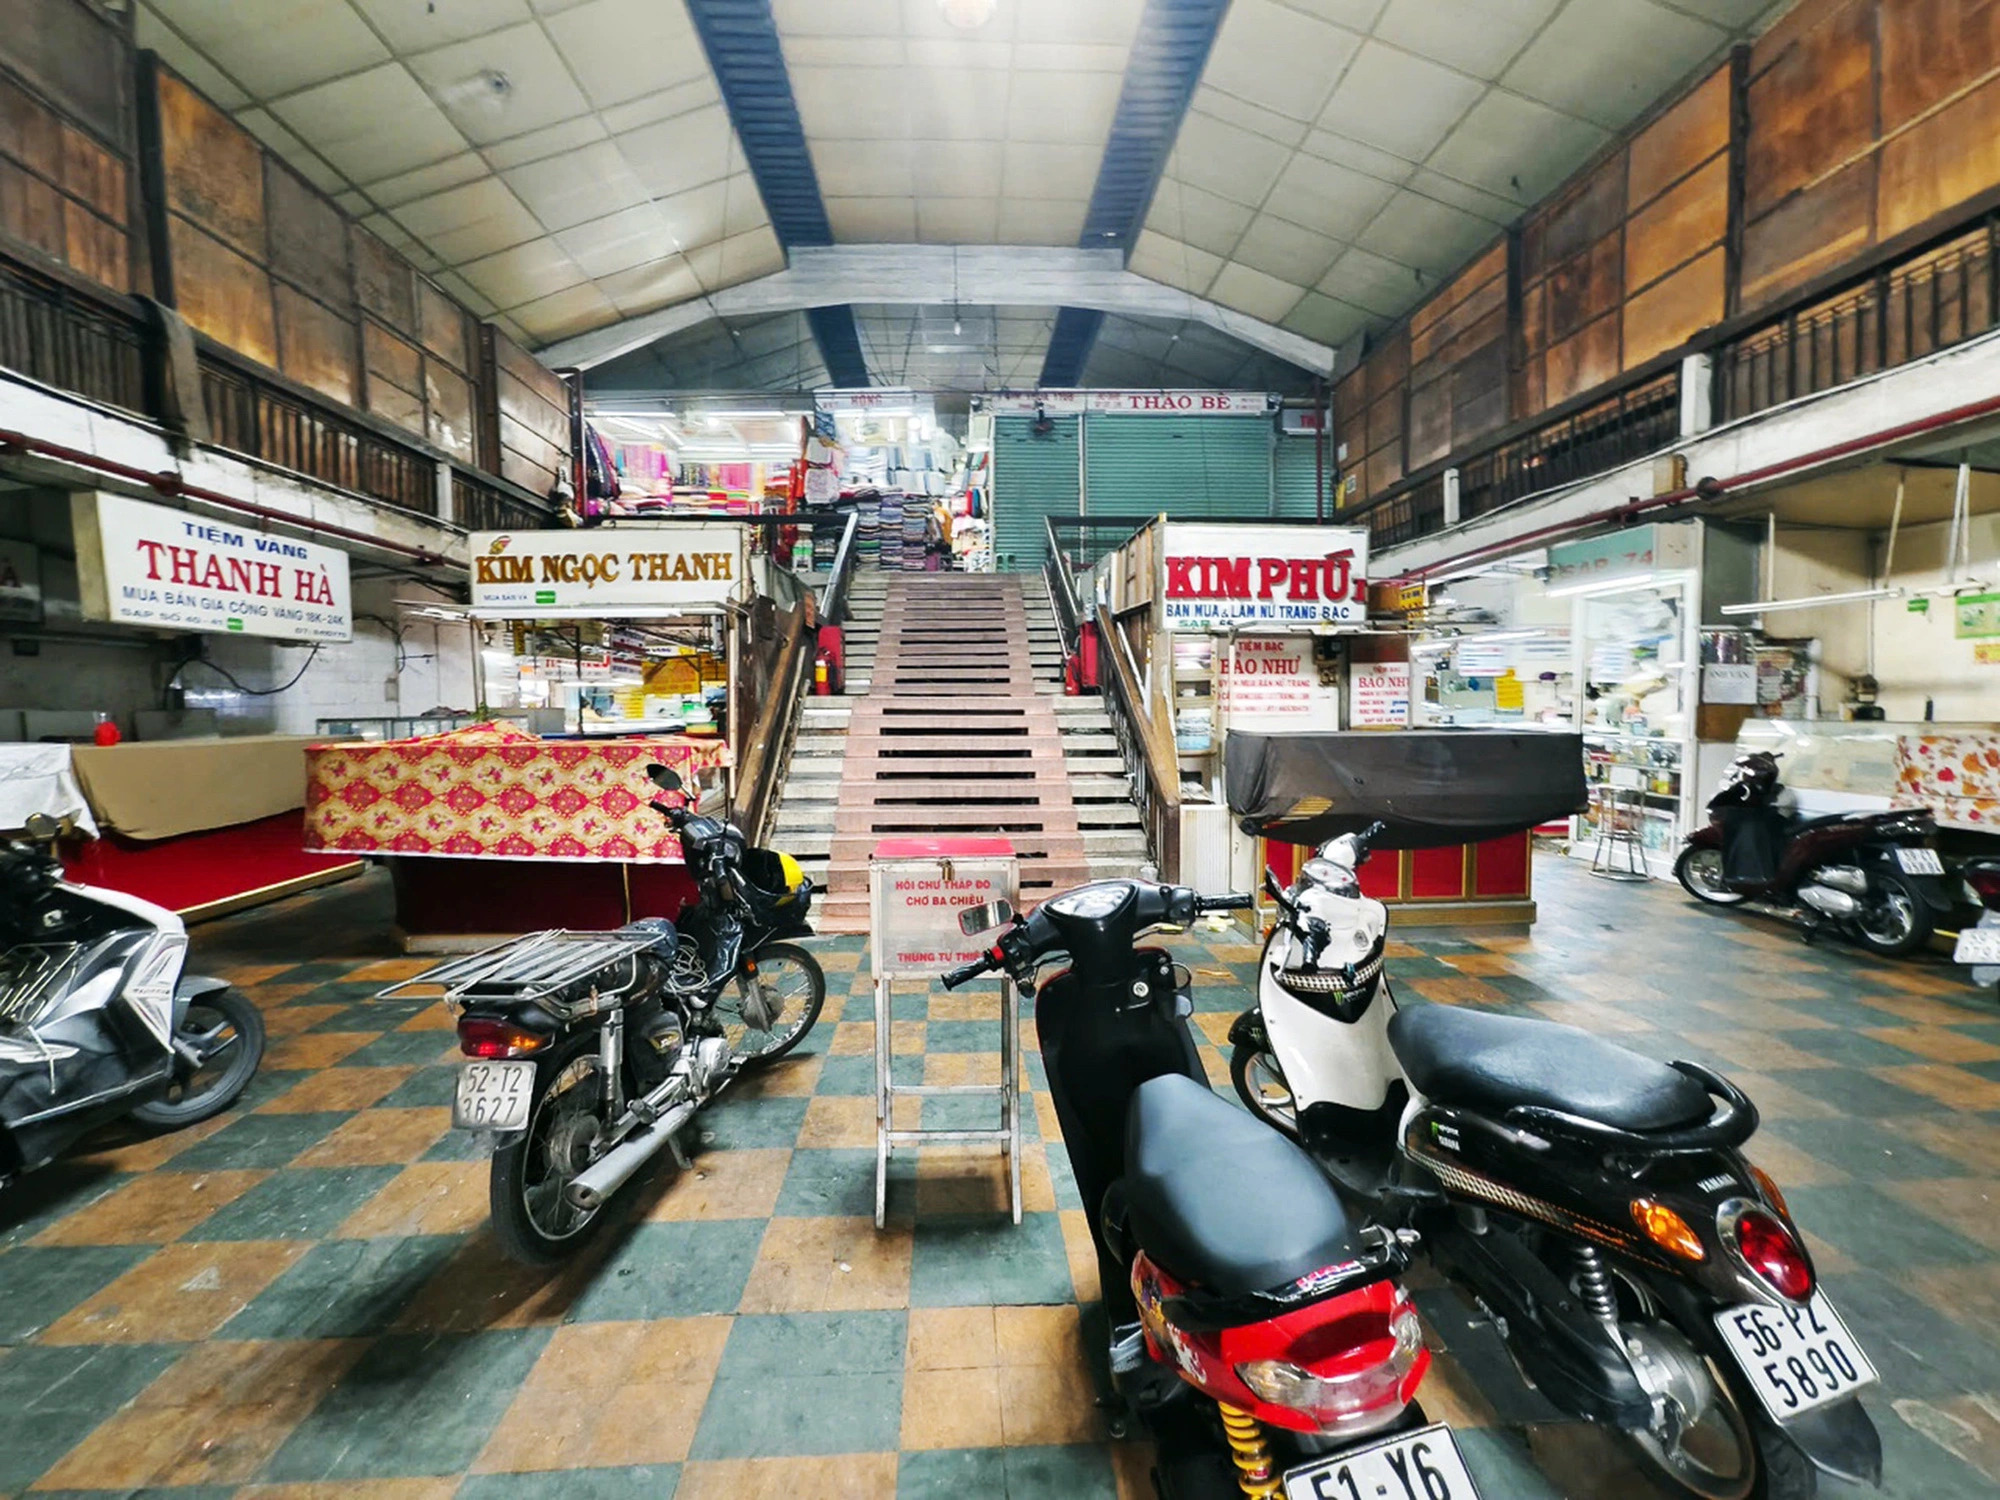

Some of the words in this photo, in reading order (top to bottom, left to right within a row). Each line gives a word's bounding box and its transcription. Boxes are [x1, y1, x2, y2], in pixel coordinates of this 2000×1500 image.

[182, 521, 244, 547] TIỆM
[137, 539, 283, 598] THANH
[295, 563, 335, 606] HÀ
[475, 555, 535, 584] KIM
[541, 553, 620, 588] NGỌC
[628, 552, 733, 581] THANH
[1165, 556, 1252, 600] KIM
[1258, 548, 1355, 602] PHÚ
[123, 585, 158, 603] MUA
[201, 597, 225, 612] GIA
[229, 599, 268, 618] CÔNG
[1195, 603, 1219, 618] MUA
[1280, 605, 1316, 619] TRANG
[1262, 655, 1301, 675] NHƯ
[468, 1066, 523, 1093] 52-T2
[463, 1096, 518, 1124] 3627
[1763, 1339, 1858, 1408] 5890
